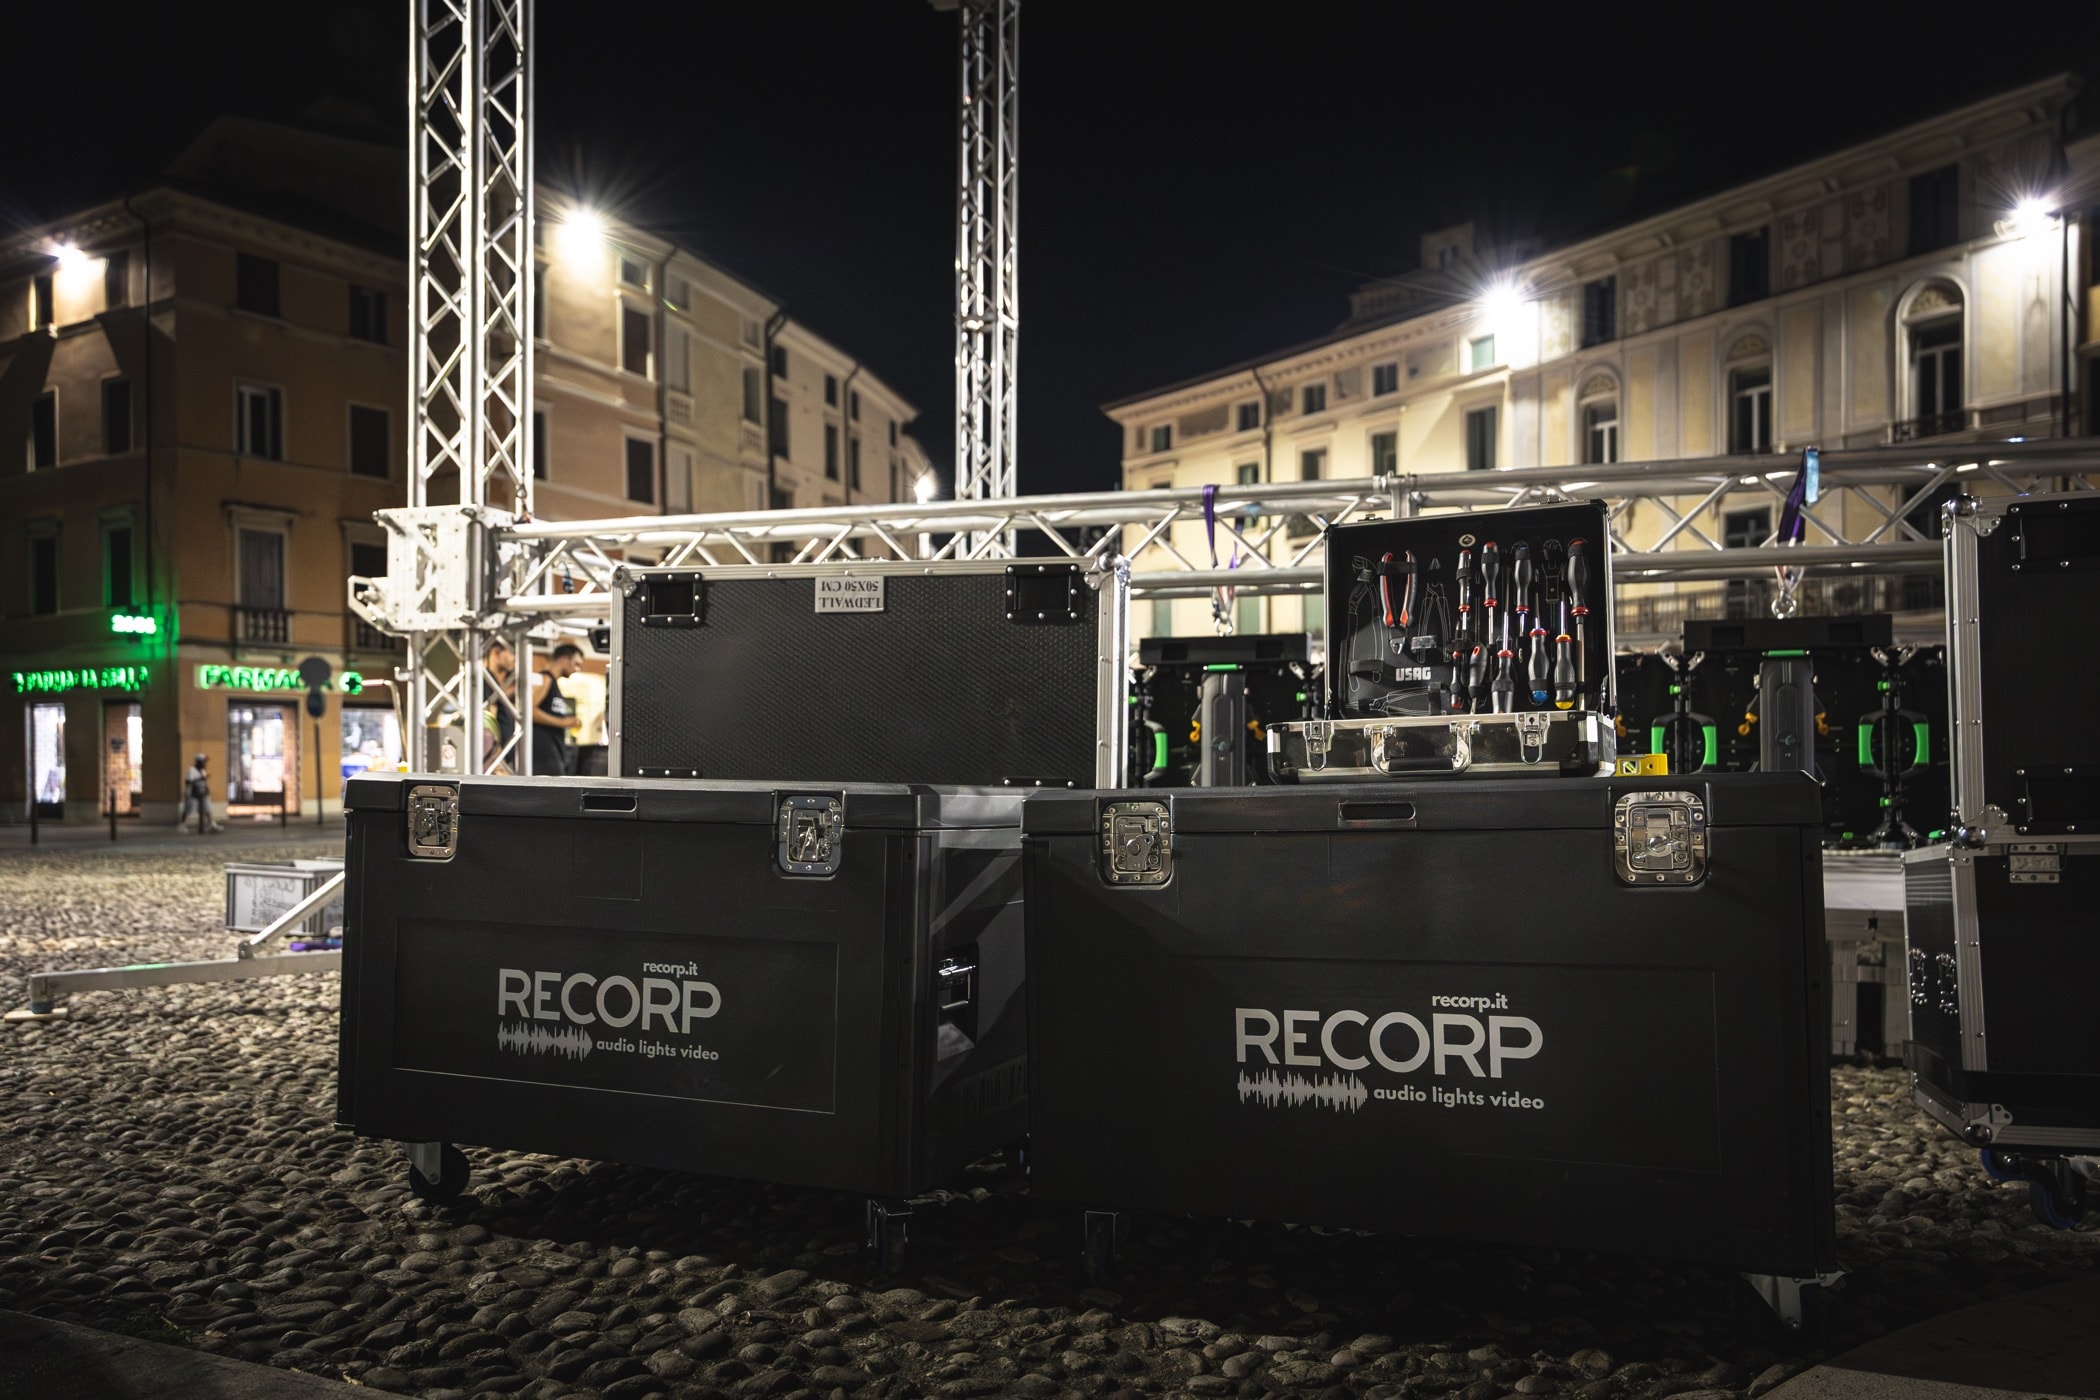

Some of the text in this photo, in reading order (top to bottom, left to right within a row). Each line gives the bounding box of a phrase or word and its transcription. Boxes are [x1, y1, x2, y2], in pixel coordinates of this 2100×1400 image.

[821, 581, 879, 592] 50X50 CM
[818, 597, 880, 608] LEDWALL
[1395, 666, 1432, 682] USAG
[643, 961, 698, 978] recorp.it
[498, 968, 722, 1034] RECORP
[1432, 992, 1508, 1013] recorp.it
[596, 1038, 720, 1061] audio lights video
[1235, 1007, 1544, 1079] RECORP
[1373, 1084, 1545, 1110] audio lights video
